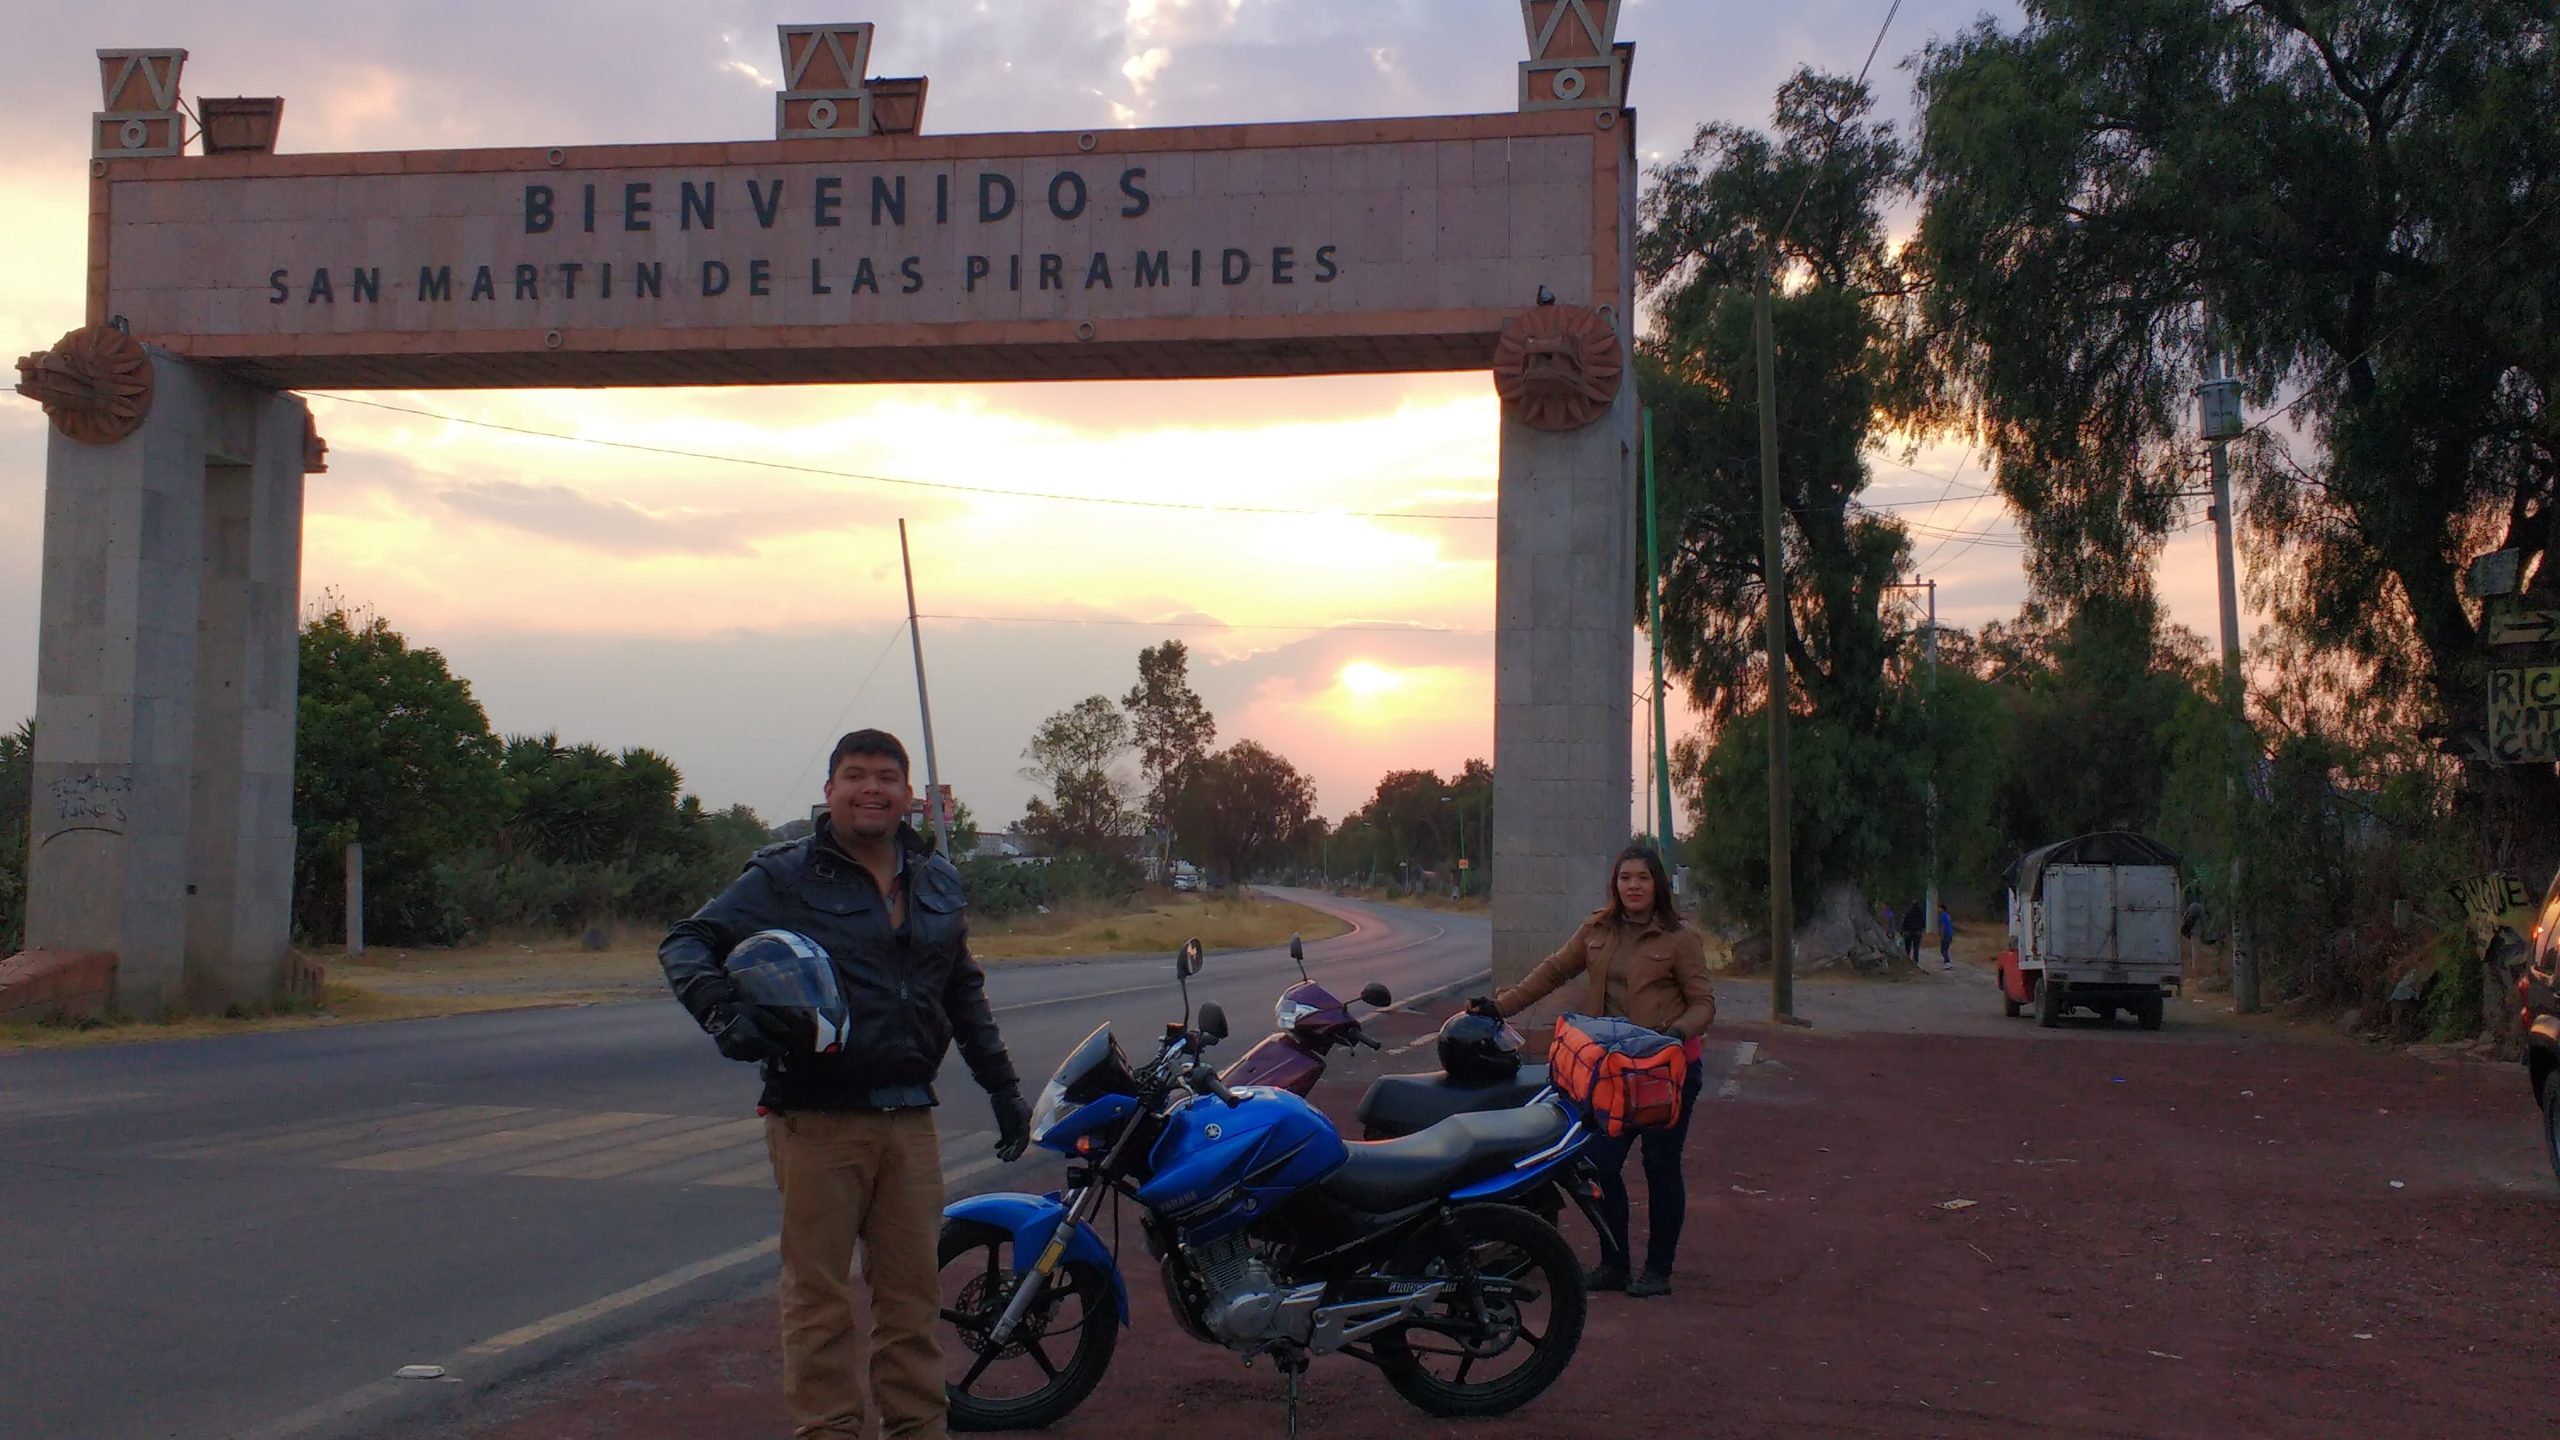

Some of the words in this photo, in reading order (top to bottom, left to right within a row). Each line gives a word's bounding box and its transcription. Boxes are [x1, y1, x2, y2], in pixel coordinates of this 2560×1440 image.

[525, 168, 1151, 234] BIENVENIDOS
[269, 267, 381, 304] SAN
[418, 262, 663, 302] MARTIN
[702, 259, 771, 296] DE
[811, 256, 924, 295] LAS
[966, 245, 1338, 293] PIRAMIDES
